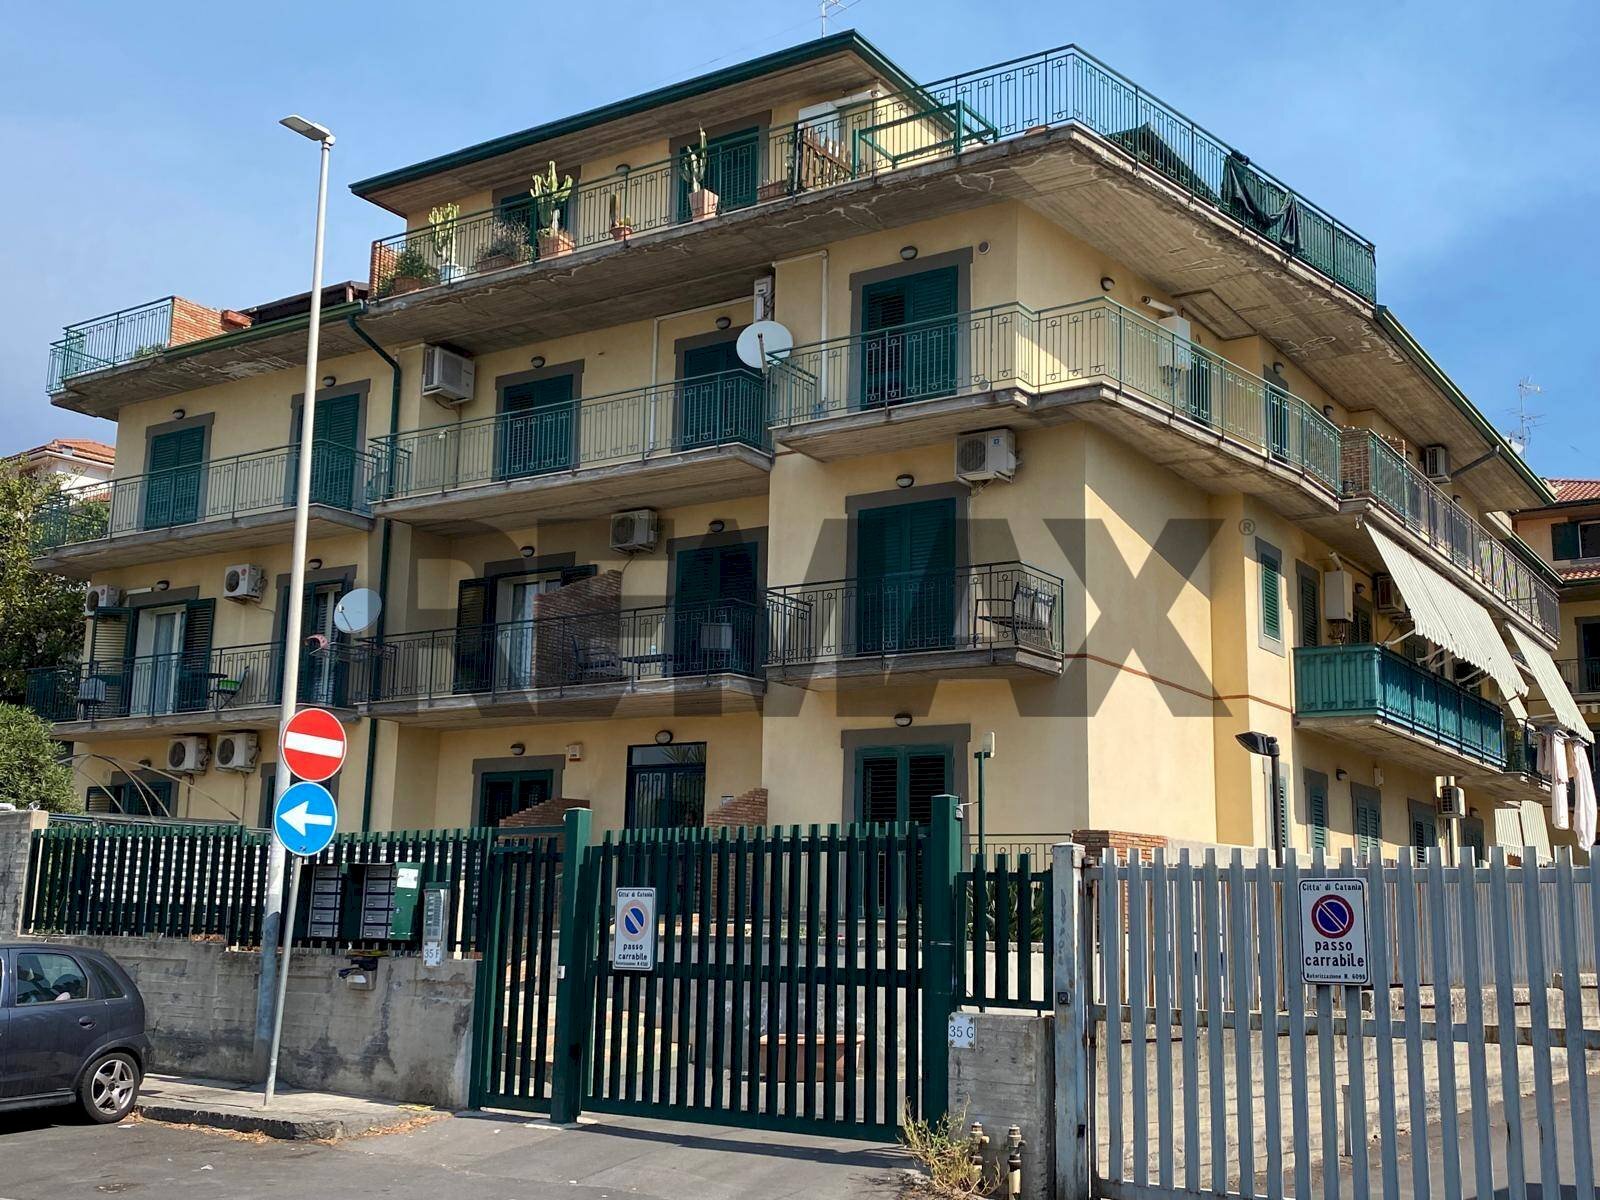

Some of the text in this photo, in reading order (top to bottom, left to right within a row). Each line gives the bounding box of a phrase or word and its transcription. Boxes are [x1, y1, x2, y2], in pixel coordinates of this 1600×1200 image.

[1302, 883, 1321, 891] Citta'
[1335, 883, 1361, 891] Catania
[1315, 941, 1352, 953] passo
[424, 949, 440, 958] 35 F
[1305, 953, 1364, 967] carrabile
[949, 1025, 974, 1039] 35 G
